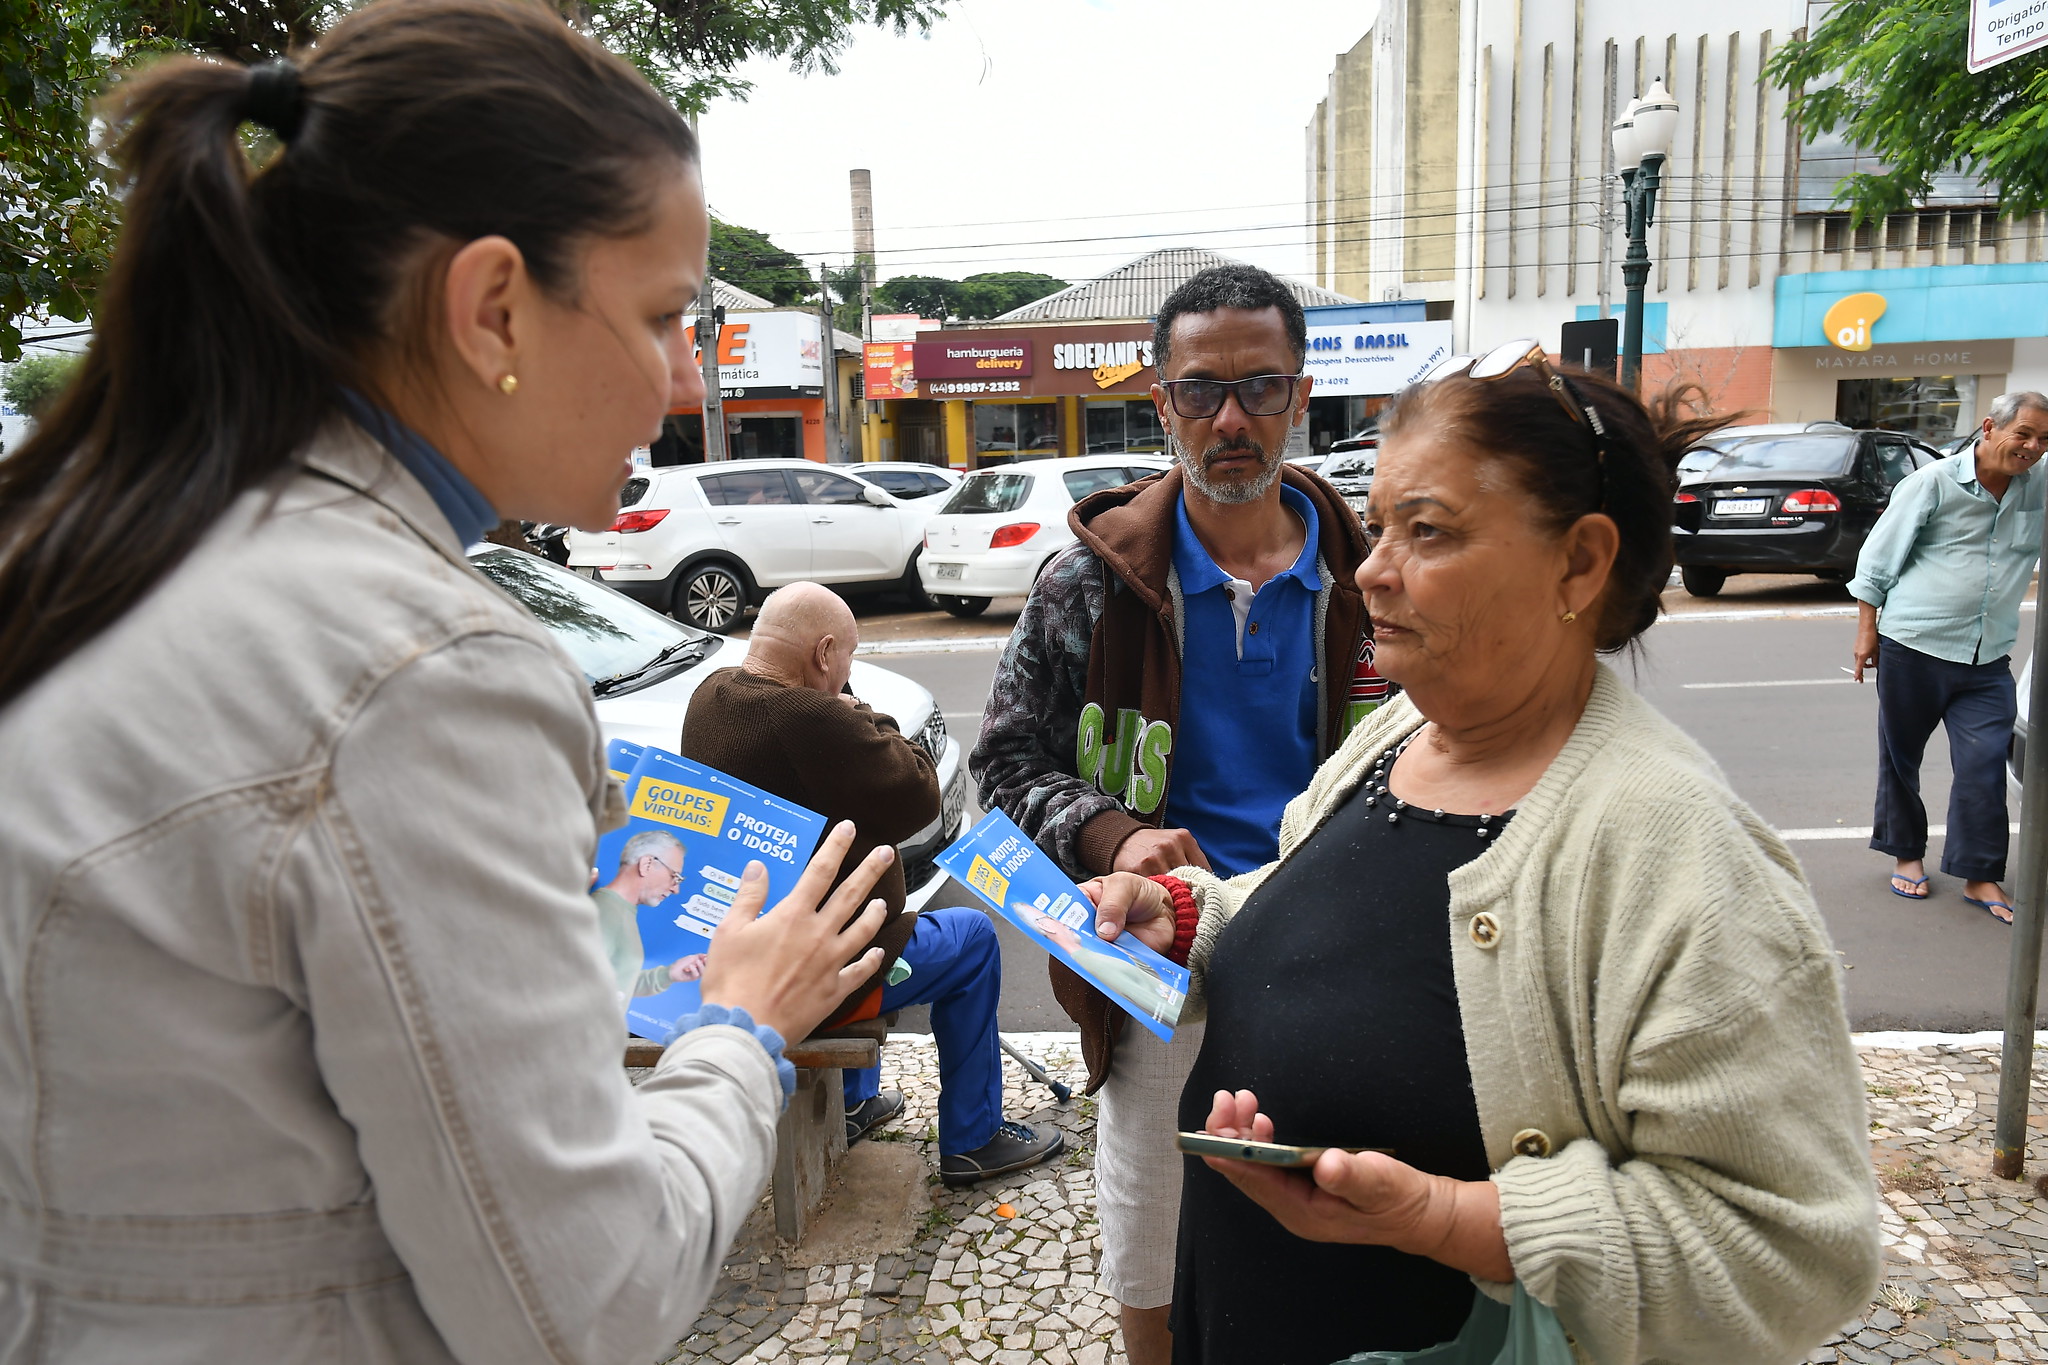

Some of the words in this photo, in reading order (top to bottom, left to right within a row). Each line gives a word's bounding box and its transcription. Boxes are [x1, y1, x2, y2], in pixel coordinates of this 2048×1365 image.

[1988, 0, 2048, 33] Obrigatór
[1997, 21, 2044, 46] Tempo
[1837, 318, 1866, 347] oi
[947, 347, 1024, 359] hamburgueria
[976, 359, 1023, 370] delivery
[1053, 341, 1154, 369] SOBERANO'S
[1345, 355, 1395, 364] Descartáveis
[1407, 363, 1430, 385] Desde
[1428, 346, 1445, 363] 1997
[1815, 354, 1898, 369] MAYARA
[1913, 352, 1972, 366] HOME
[719, 368, 759, 380] mática
[648, 785, 716, 813] GOLPES
[644, 801, 712, 828] VIRTUAIS:
[734, 812, 798, 848] PROTEJA
[727, 827, 742, 841] O
[742, 833, 795, 865] IDOSO.
[988, 835, 1021, 866] PROTEJA
[1005, 846, 1034, 873] IDOSO.
[1001, 866, 1012, 878] O
